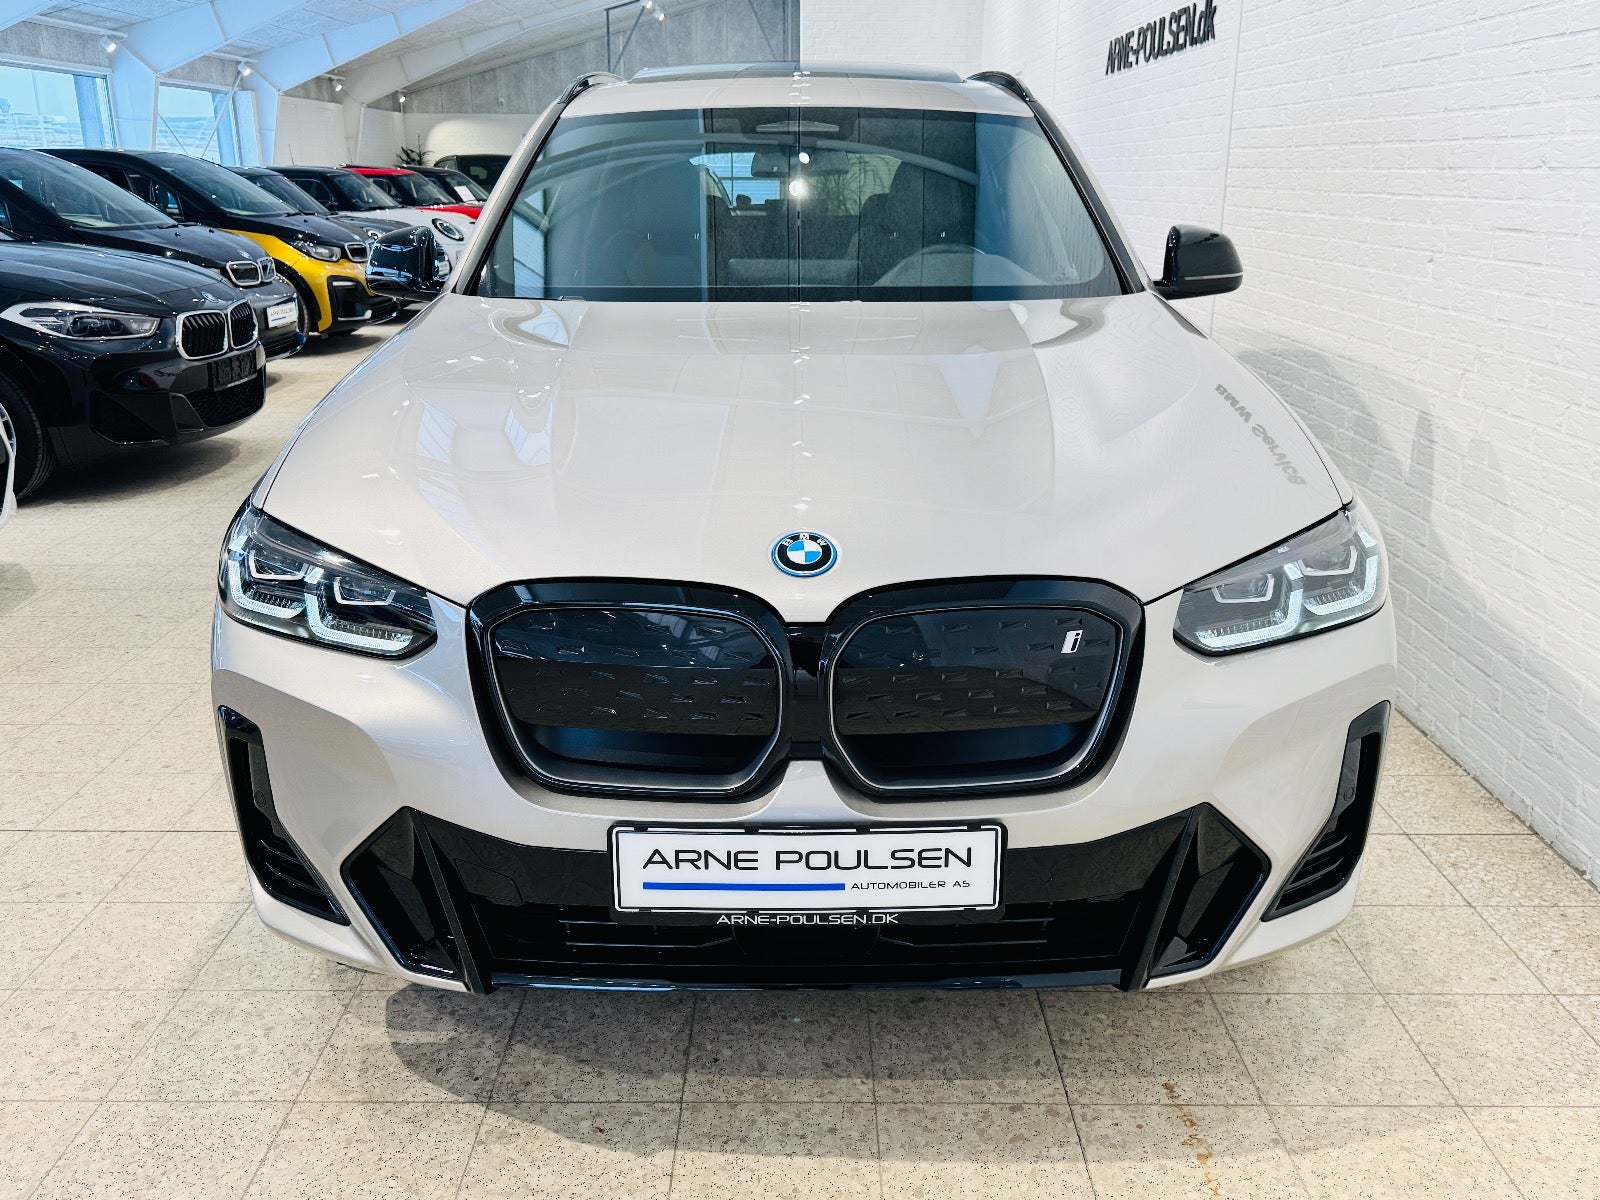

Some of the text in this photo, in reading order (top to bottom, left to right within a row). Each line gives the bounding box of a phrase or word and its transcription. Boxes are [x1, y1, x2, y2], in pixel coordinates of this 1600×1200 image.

[642, 847, 972, 870] ARNE POULSEN
[851, 880, 971, 890] AUTOMOBILER AS
[716, 914, 899, 925] ARNE-POULSEN.DK
